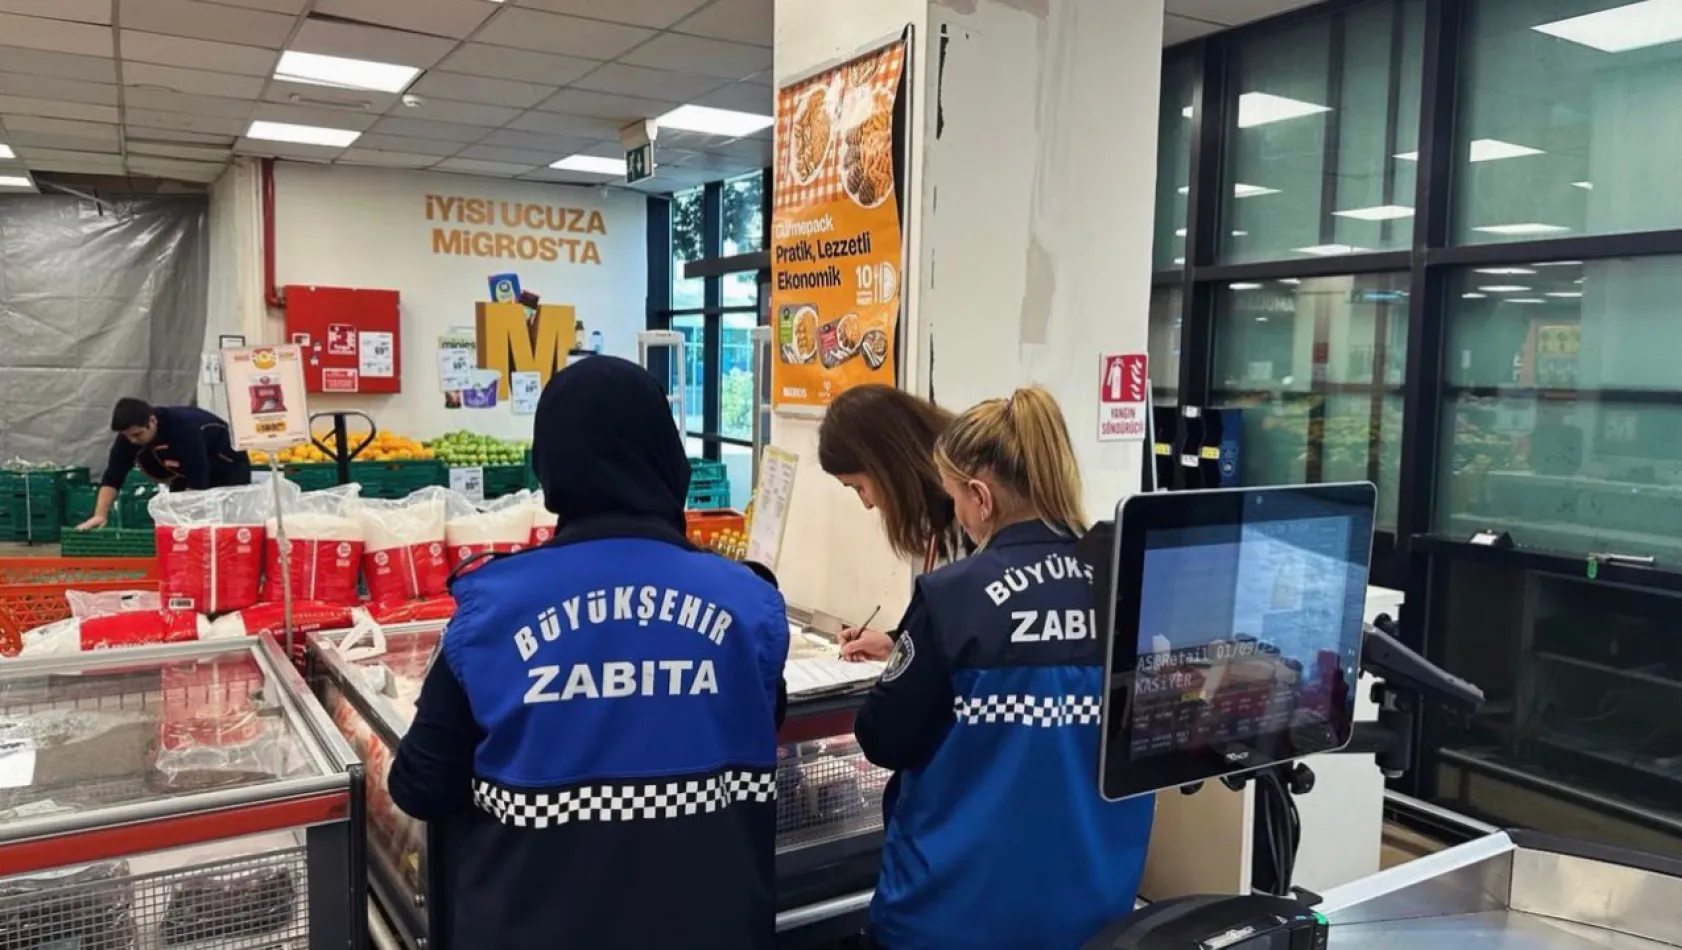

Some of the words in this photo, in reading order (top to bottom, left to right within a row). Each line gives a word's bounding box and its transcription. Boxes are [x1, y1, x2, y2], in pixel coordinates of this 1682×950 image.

[501, 201, 607, 235] UCUZA
[776, 240, 816, 264] Pratik,
[817, 231, 871, 259] Lezzetli
[778, 265, 841, 290] Ekonomik
[856, 264, 872, 288] 10
[1110, 407, 1136, 418] YANGIN
[513, 585, 732, 661] BÜYÜKŞEHİR
[523, 660, 718, 704] ZABITA
